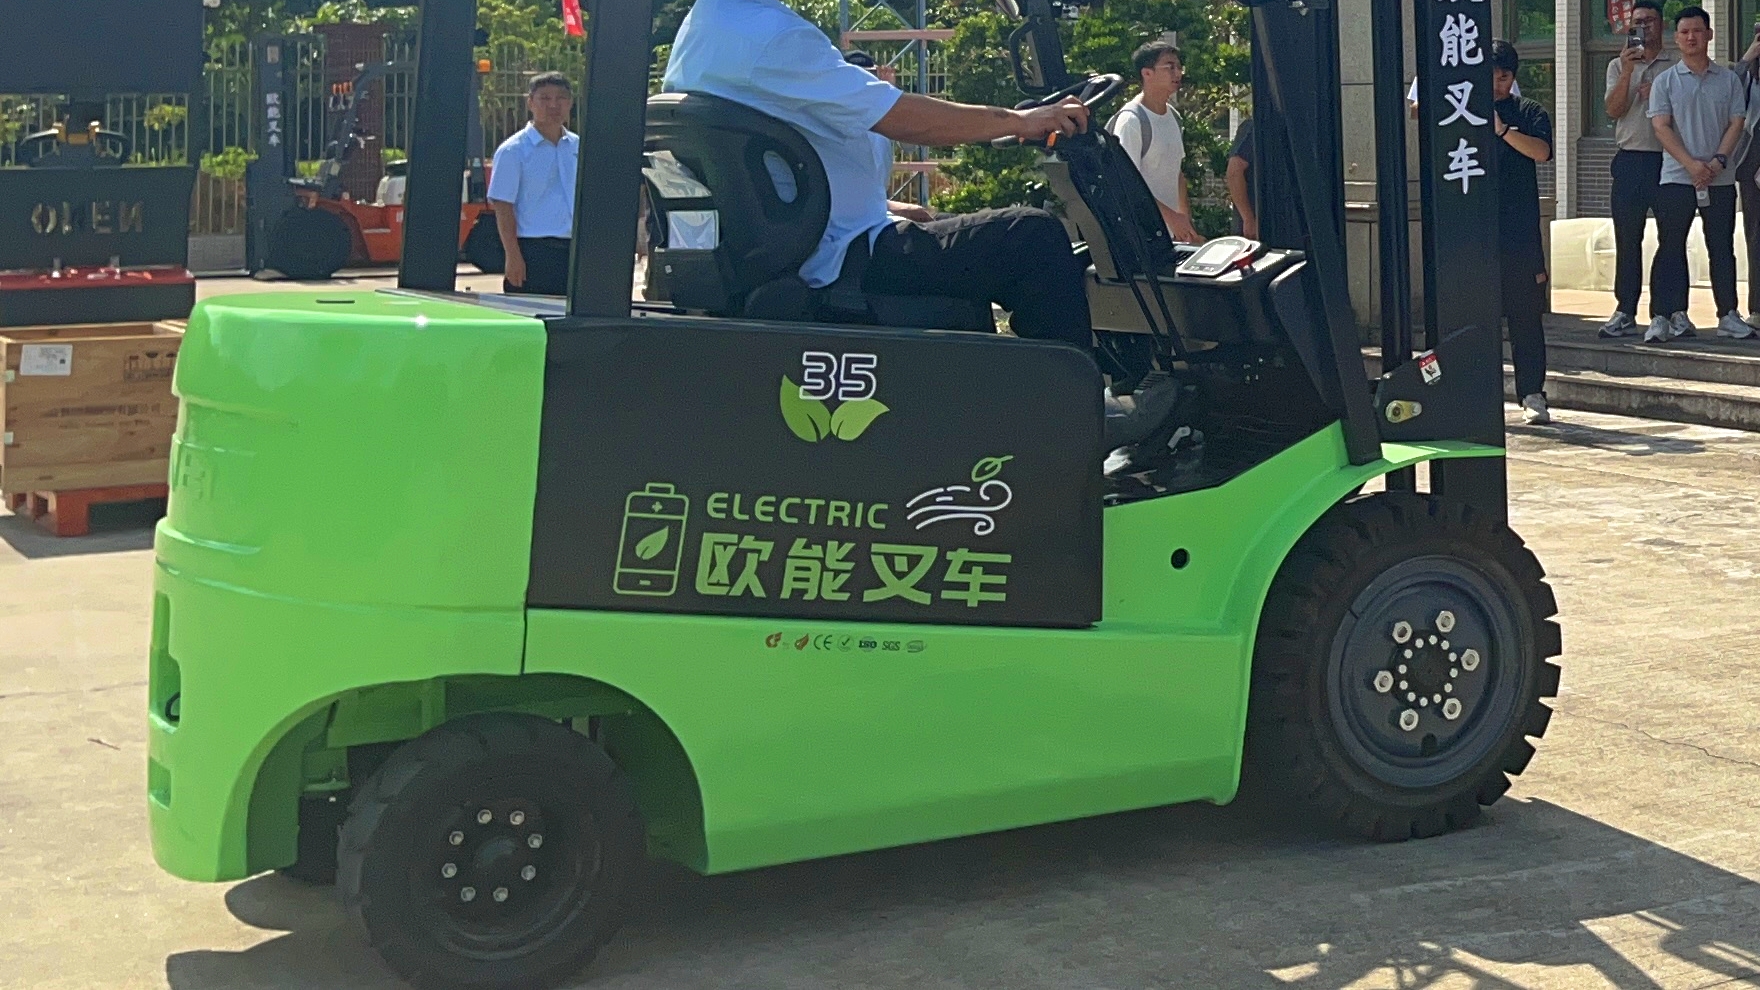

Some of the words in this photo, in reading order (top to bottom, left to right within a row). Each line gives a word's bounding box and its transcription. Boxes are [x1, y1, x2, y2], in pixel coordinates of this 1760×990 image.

[799, 351, 878, 401] 35
[707, 492, 888, 529] ELECTRIC
[695, 532, 1013, 607] 欧能叉车
[813, 634, 833, 650] CE
[882, 641, 900, 651] SGS
